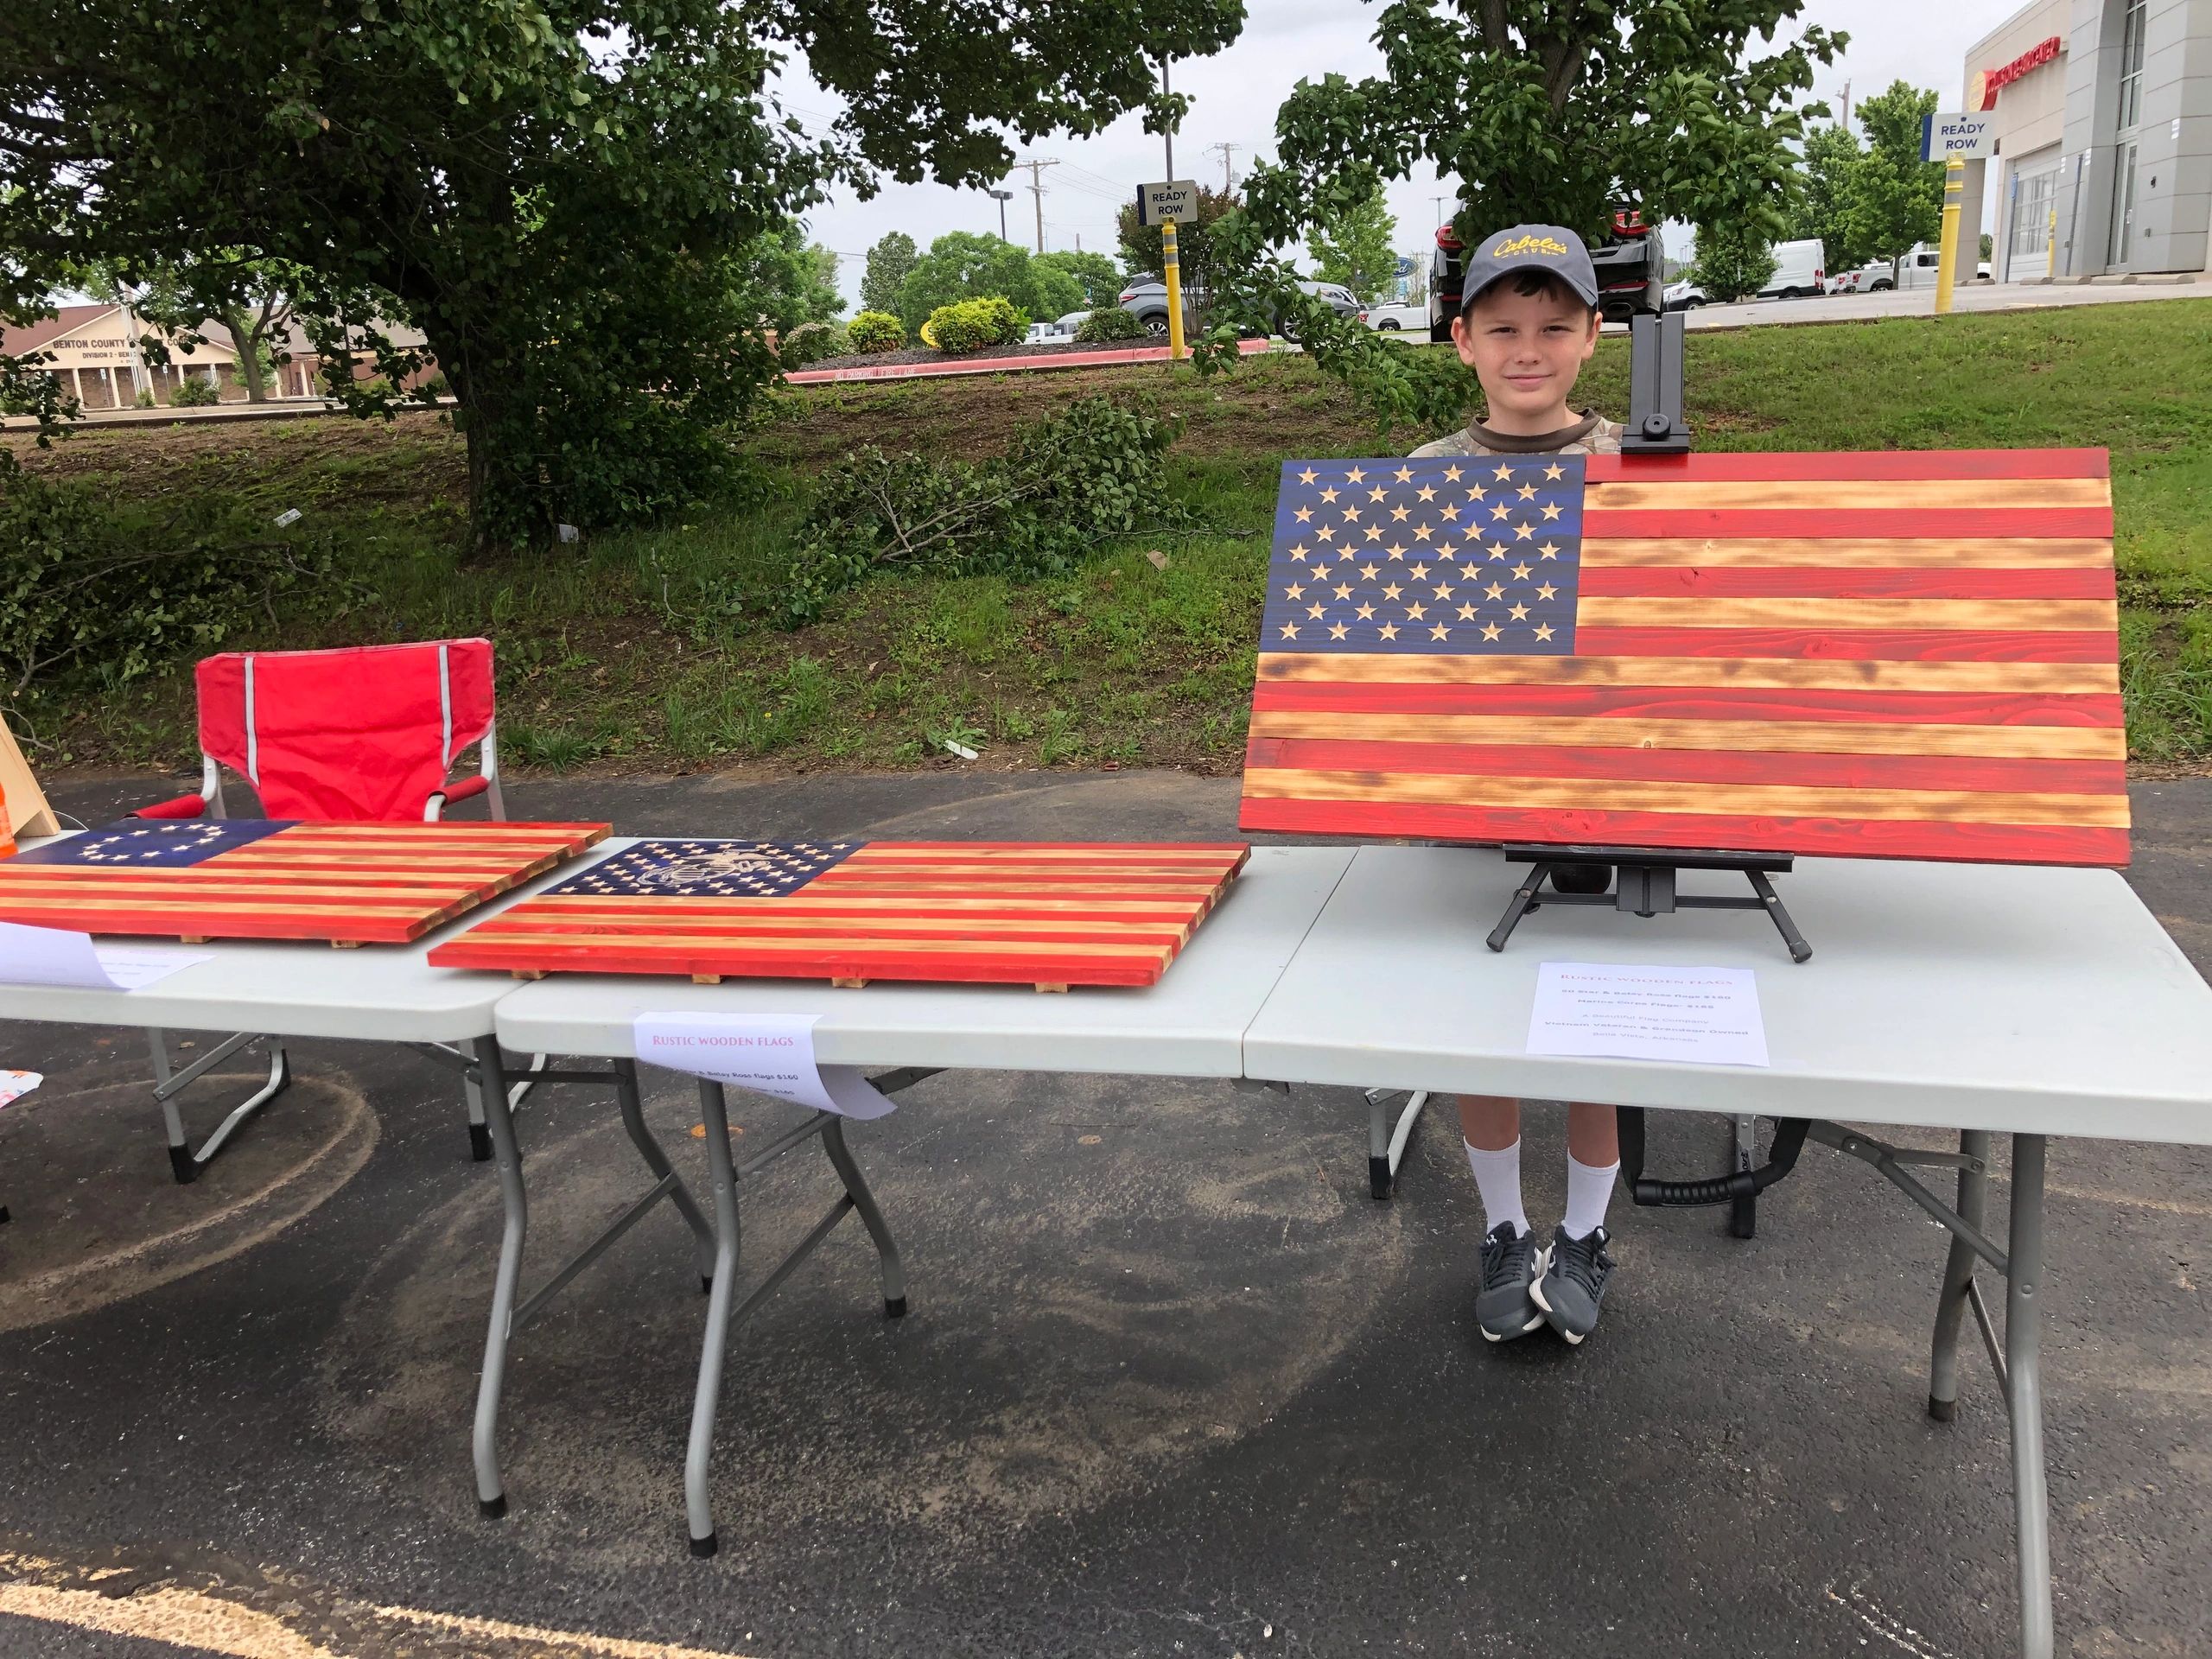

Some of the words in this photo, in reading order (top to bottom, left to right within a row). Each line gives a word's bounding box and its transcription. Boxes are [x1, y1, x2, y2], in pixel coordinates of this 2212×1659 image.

[1941, 123, 1986, 136] READY
[1946, 138, 1978, 149] ROW
[1152, 191, 1187, 202] READY
[1158, 205, 1184, 214] ROW
[1493, 234, 1567, 257] Cabela's
[53, 339, 89, 349] BENTON
[91, 339, 125, 348] COUNTY
[835, 371, 843, 379] NO
[847, 370, 874, 379] PARKING
[881, 368, 895, 377] FIRE
[899, 367, 917, 376] LANE
[652, 1035, 695, 1046] RUSTIC
[699, 1037, 753, 1046] WOODEN
[758, 1037, 794, 1046] FLAGS
